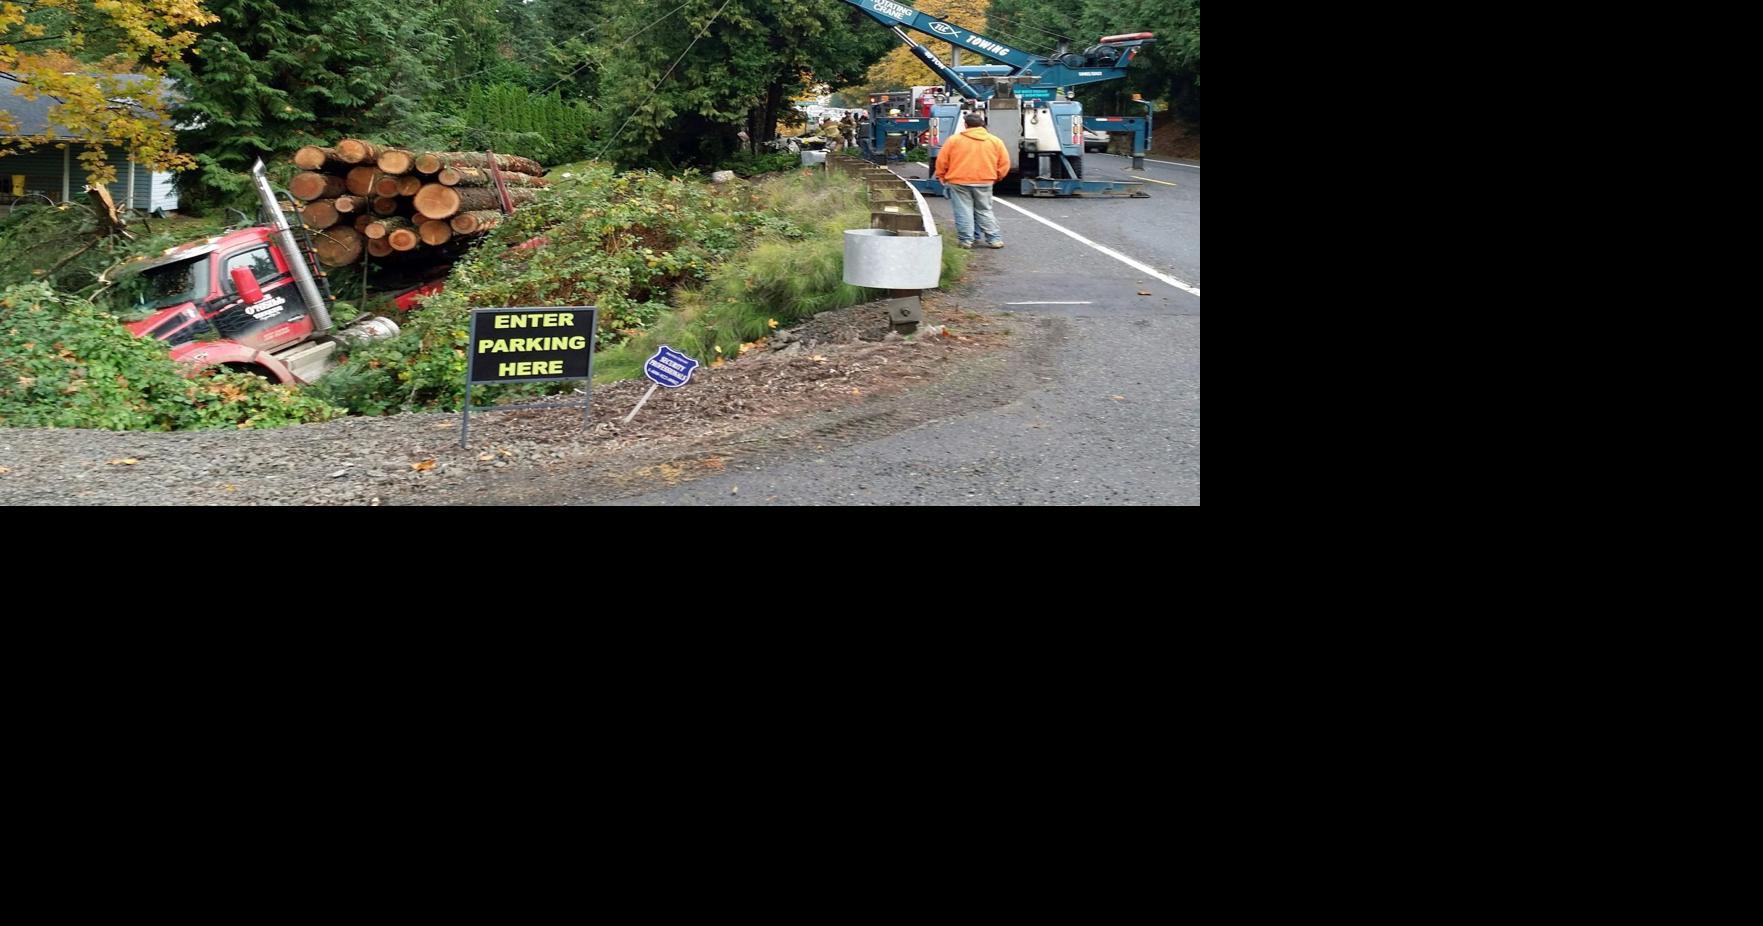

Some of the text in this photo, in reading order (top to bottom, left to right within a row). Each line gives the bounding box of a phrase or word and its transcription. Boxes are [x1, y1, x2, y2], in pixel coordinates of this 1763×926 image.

[871, 0, 913, 16] OTATING
[873, 4, 904, 20] CRANE
[965, 35, 1010, 56] TOWING
[494, 312, 575, 329] ENTER
[478, 336, 586, 354] PARKING
[498, 360, 564, 377] HERE
[649, 360, 688, 381] PROFESSIONALS
[659, 356, 686, 372] SECURITY
